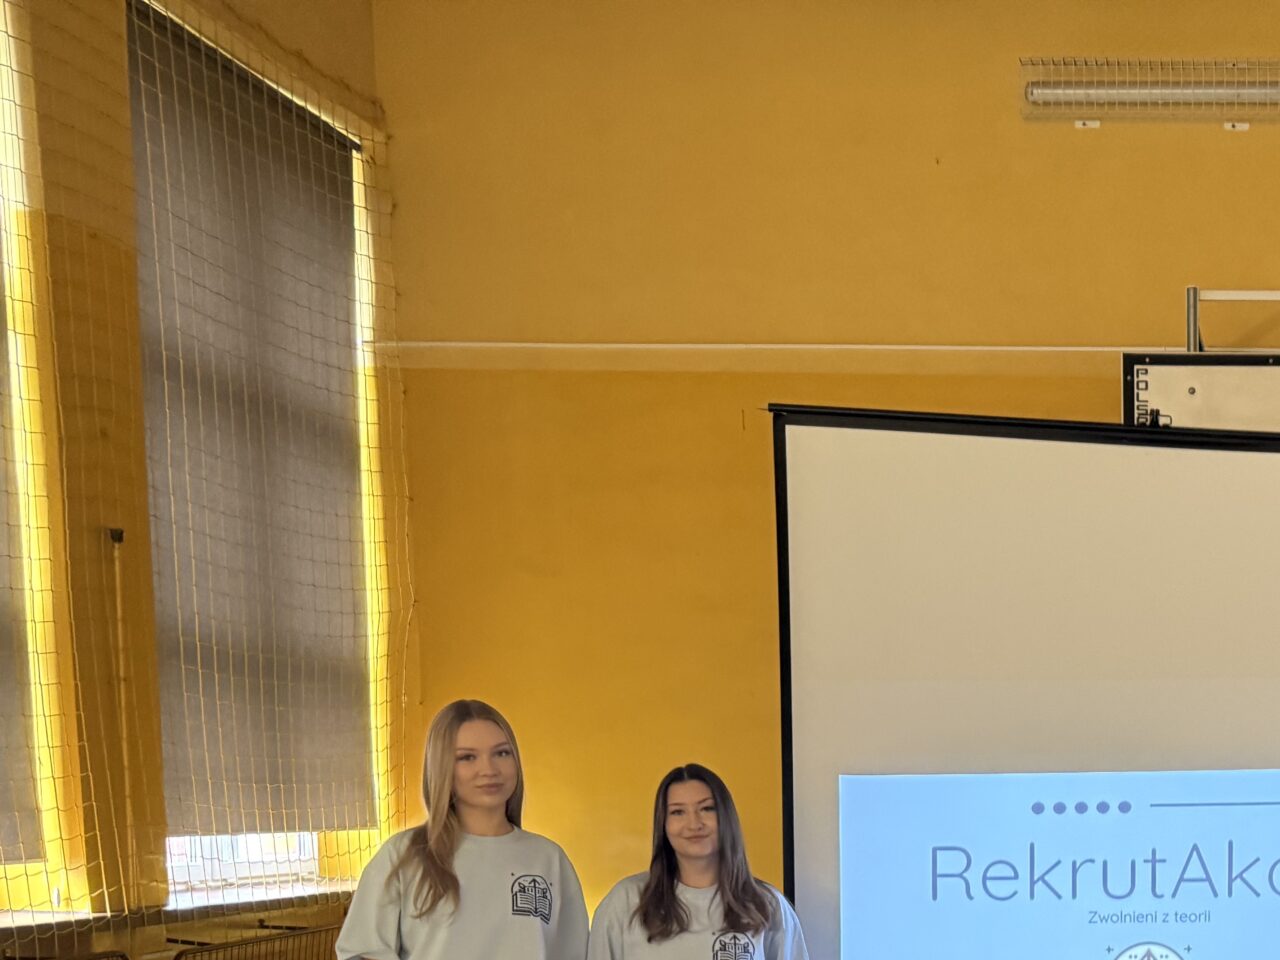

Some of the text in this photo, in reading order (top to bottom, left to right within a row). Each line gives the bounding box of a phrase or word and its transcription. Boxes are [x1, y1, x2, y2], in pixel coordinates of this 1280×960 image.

[1087, 910, 1212, 924] Zwolnieni z teorii
